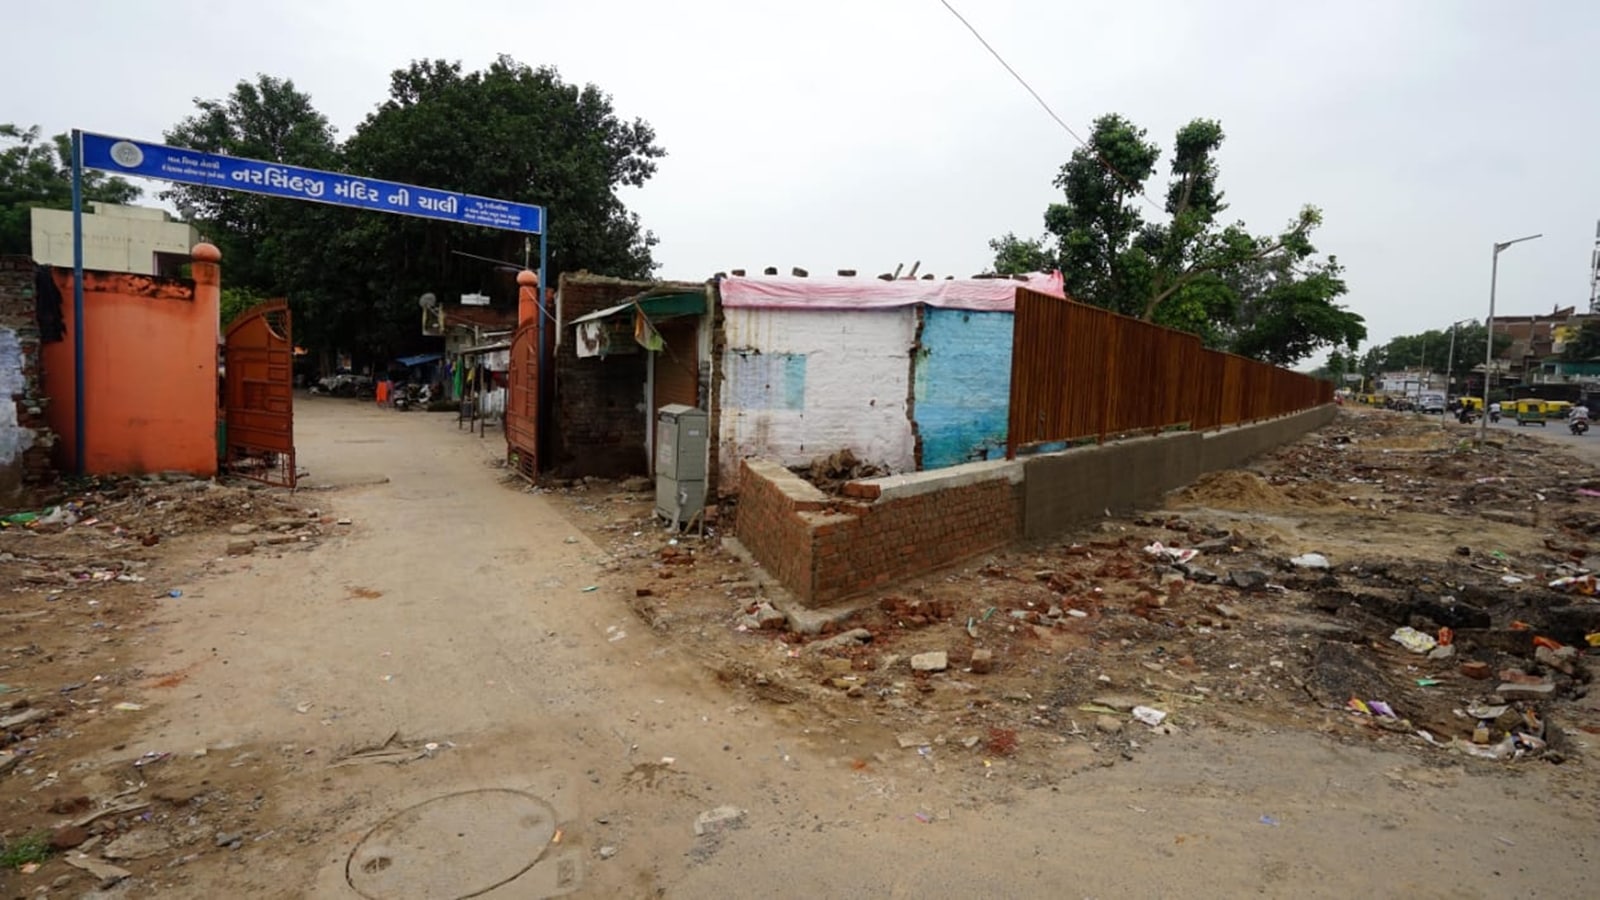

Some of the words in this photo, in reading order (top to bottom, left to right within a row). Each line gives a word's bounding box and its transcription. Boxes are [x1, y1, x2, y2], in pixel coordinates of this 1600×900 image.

[231, 167, 325, 196] નરસિંહજી
[334, 180, 379, 202] મંદિર
[388, 188, 410, 207] ની
[417, 195, 458, 214] ચાલી
